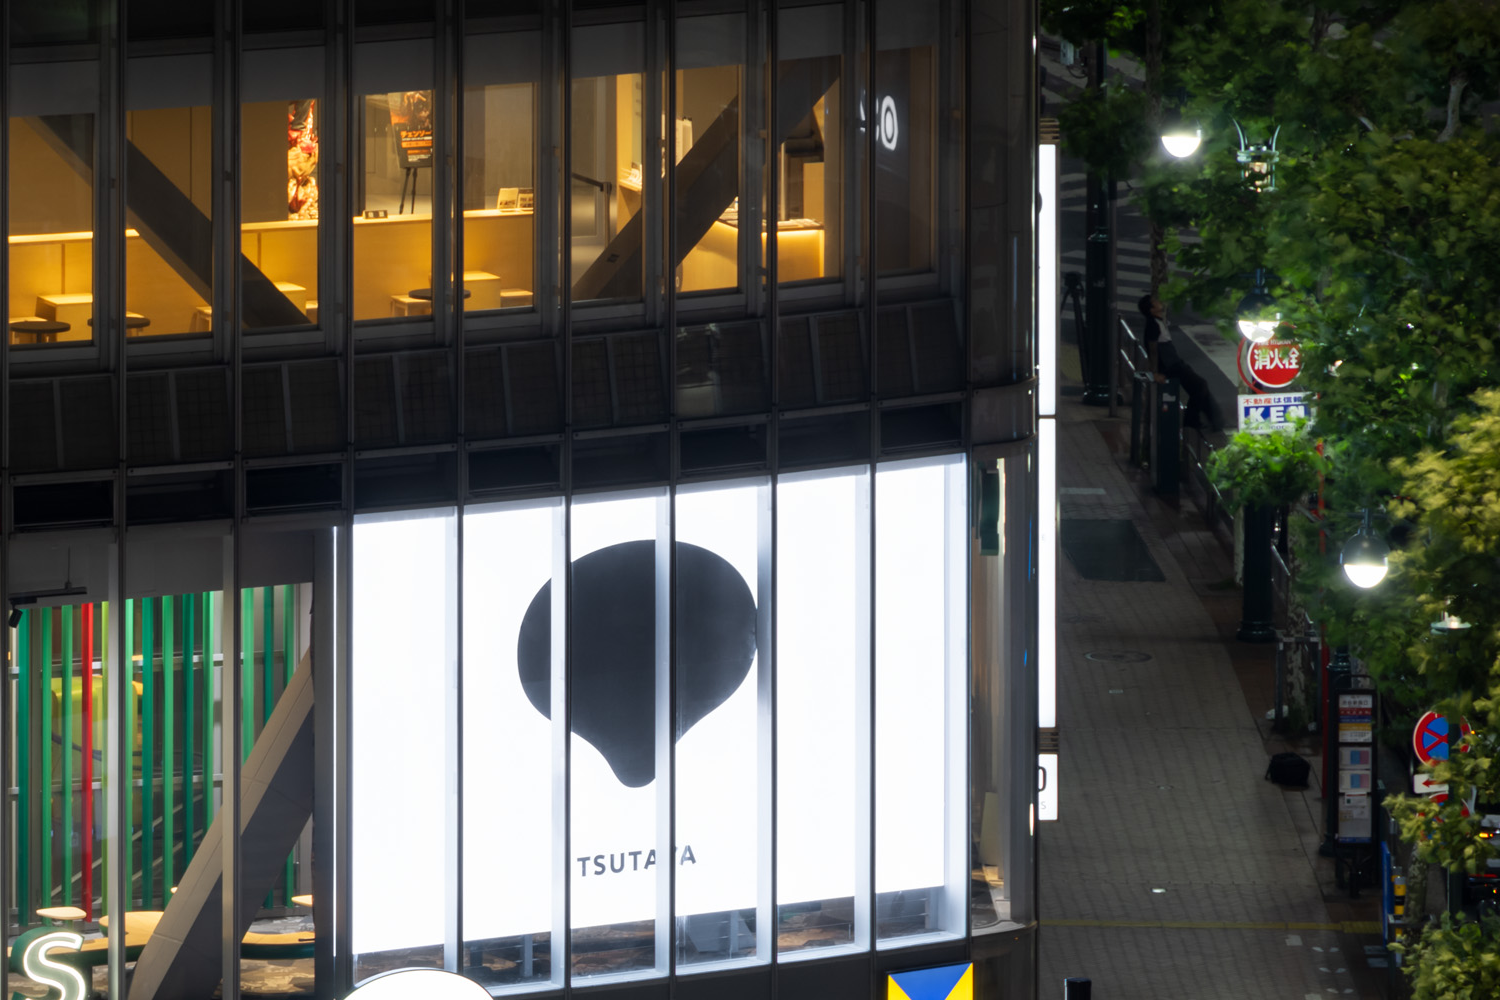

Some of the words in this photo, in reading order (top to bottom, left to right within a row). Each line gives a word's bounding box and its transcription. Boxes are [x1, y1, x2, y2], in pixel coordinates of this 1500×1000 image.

[1254, 347, 1300, 370] 消火栓
[577, 845, 696, 877] TSUTAA
